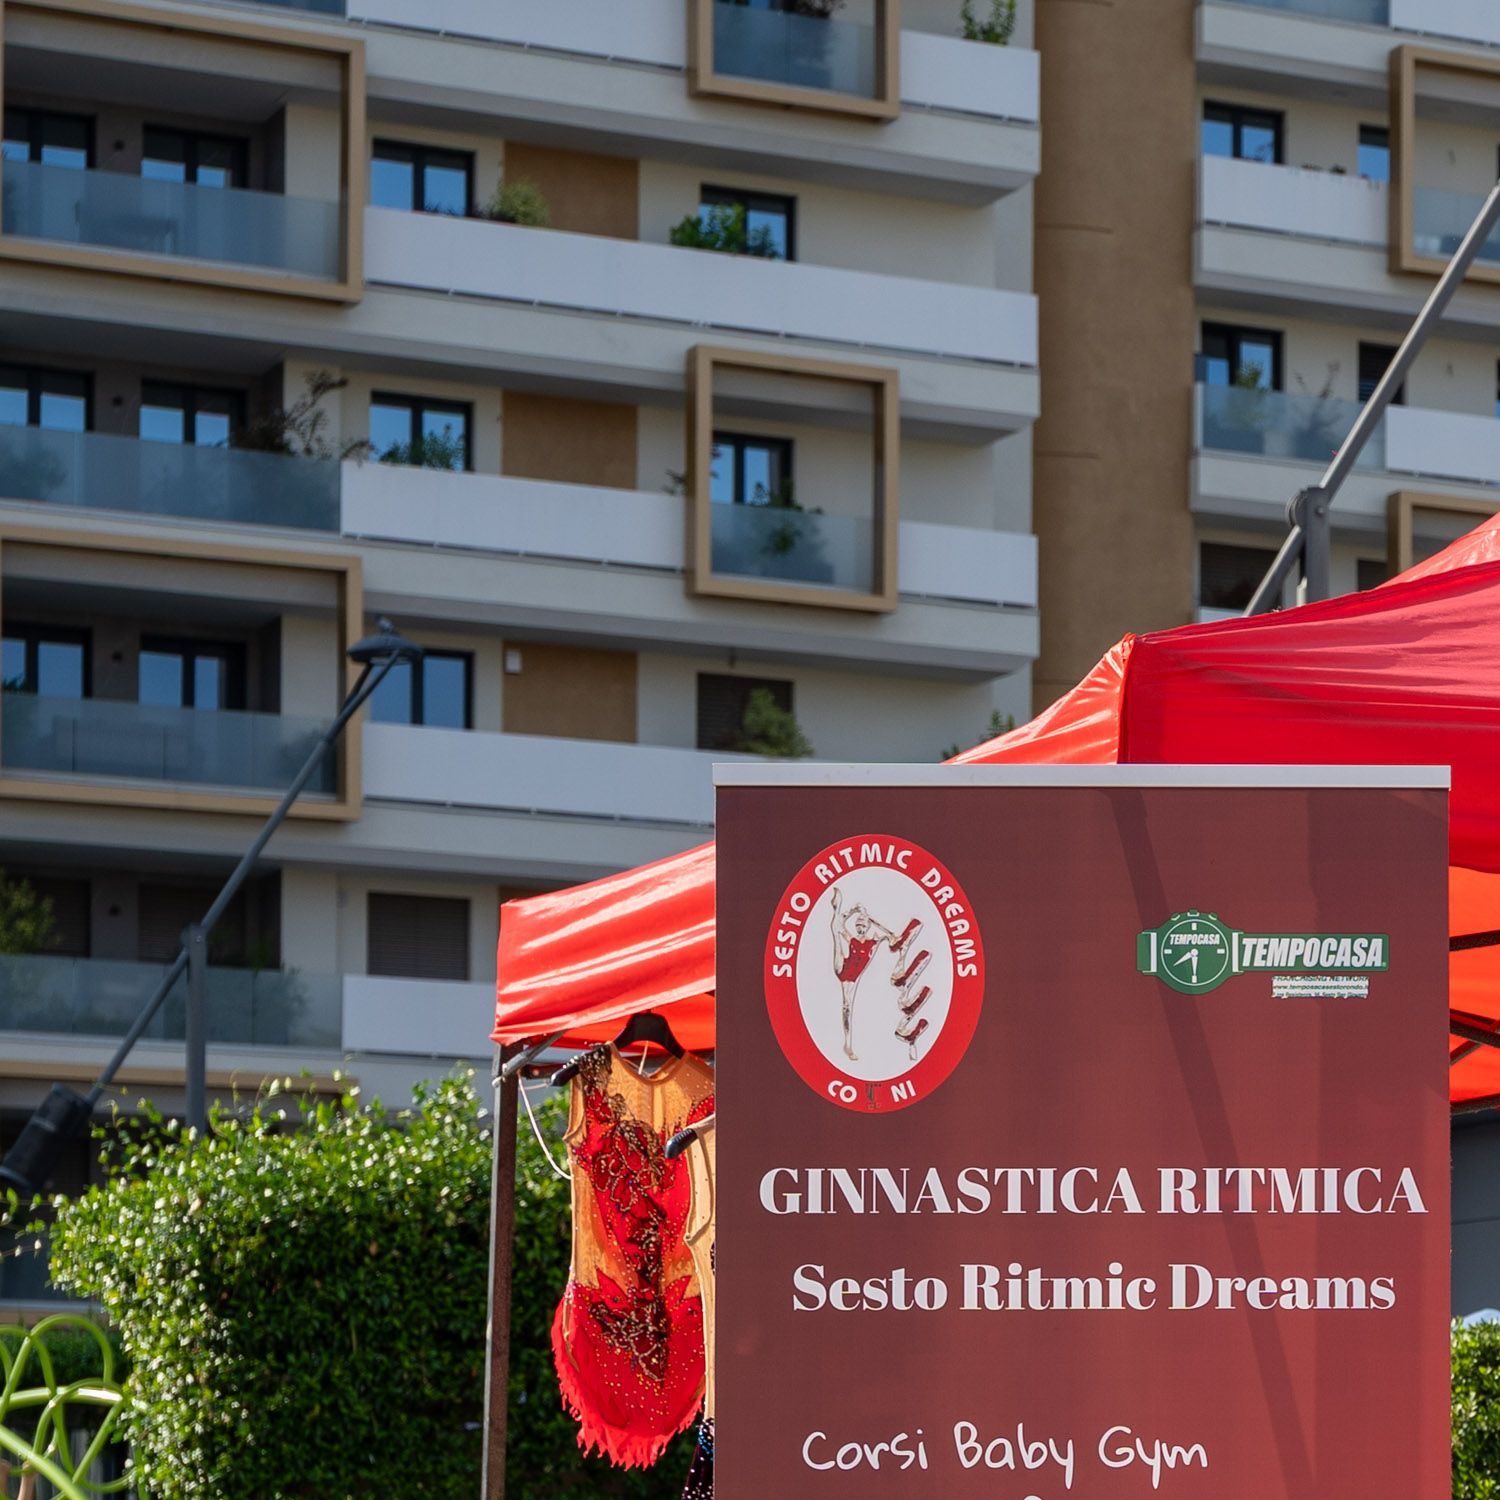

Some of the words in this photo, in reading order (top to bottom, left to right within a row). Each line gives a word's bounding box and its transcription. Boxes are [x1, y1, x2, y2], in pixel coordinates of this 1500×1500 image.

[773, 892, 811, 978] SESTO
[814, 842, 913, 884] RITMIC
[920, 867, 978, 978] DREAMS
[1169, 933, 1221, 945] TEMPOCASA
[1242, 938, 1384, 968] TEMPOCASA
[827, 1080, 858, 1103] CO
[891, 1079, 917, 1103] NI
[759, 1166, 1146, 1215] GINNASTICA
[1156, 1166, 1429, 1215] RITMICA
[793, 1263, 948, 1311] Sesto
[959, 1262, 1156, 1311] Ritmic
[1168, 1263, 1396, 1311] Dreams
[802, 1428, 928, 1470] Corsi
[953, 1420, 1075, 1489] Baby
[1098, 1425, 1209, 1490] Gym
